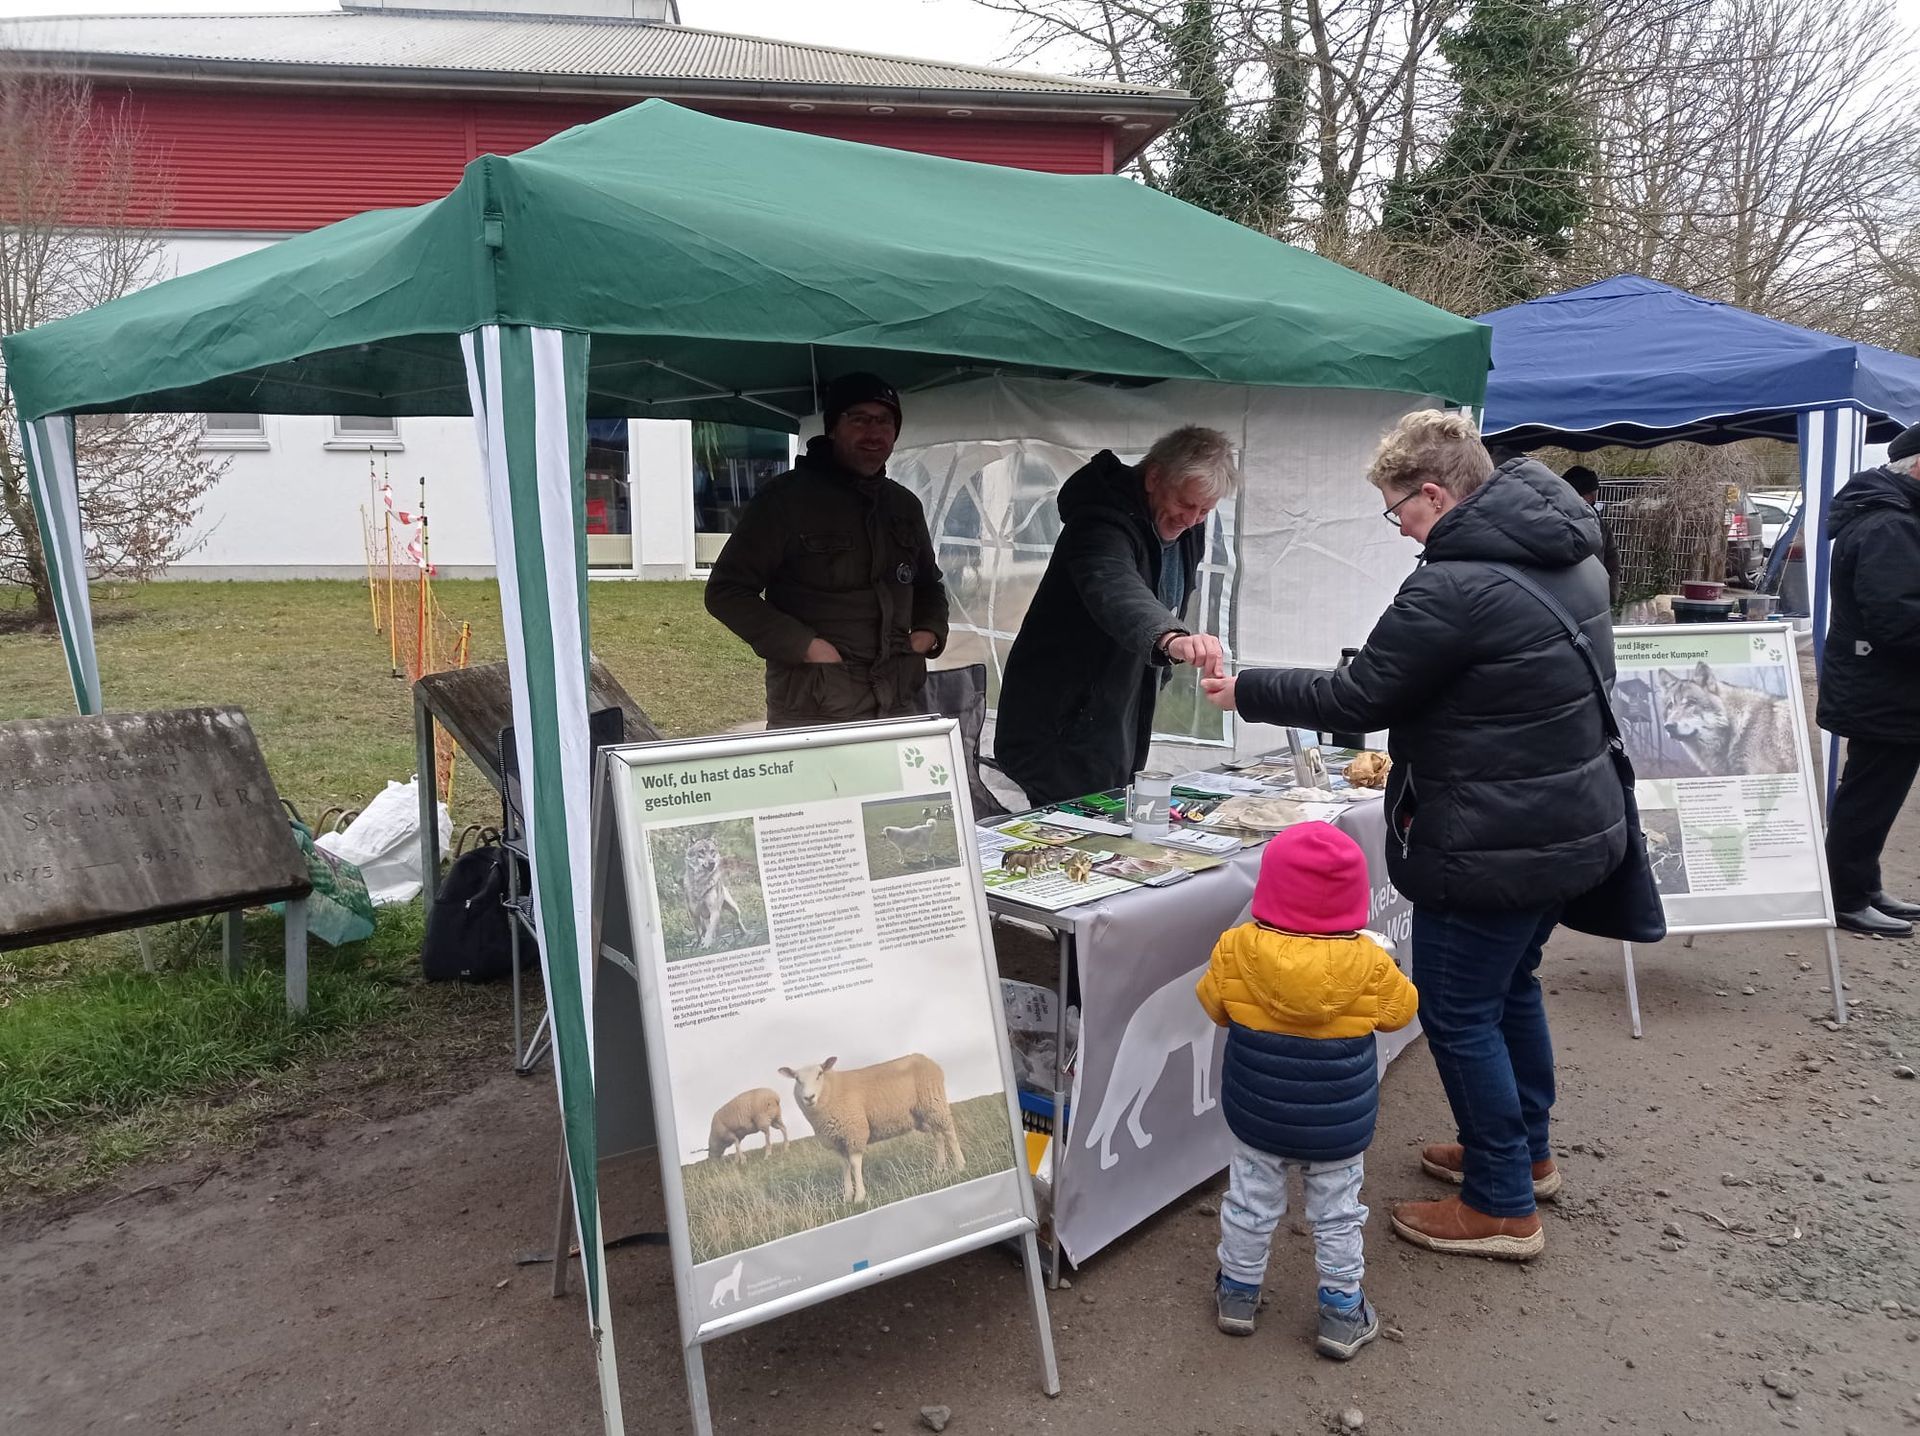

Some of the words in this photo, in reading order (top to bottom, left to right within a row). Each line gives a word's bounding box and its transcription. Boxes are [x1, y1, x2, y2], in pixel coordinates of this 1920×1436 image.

[1617, 642, 1632, 650] und
[1633, 641, 1654, 651] Jäger
[1651, 651, 1669, 660] oder
[1670, 649, 1709, 660] Kumpane?
[642, 773, 677, 789] Wolf,
[680, 771, 697, 785] du
[700, 768, 729, 783] hast
[733, 766, 756, 780] das
[759, 760, 794, 777] Schaf
[644, 790, 712, 811] gestohlen
